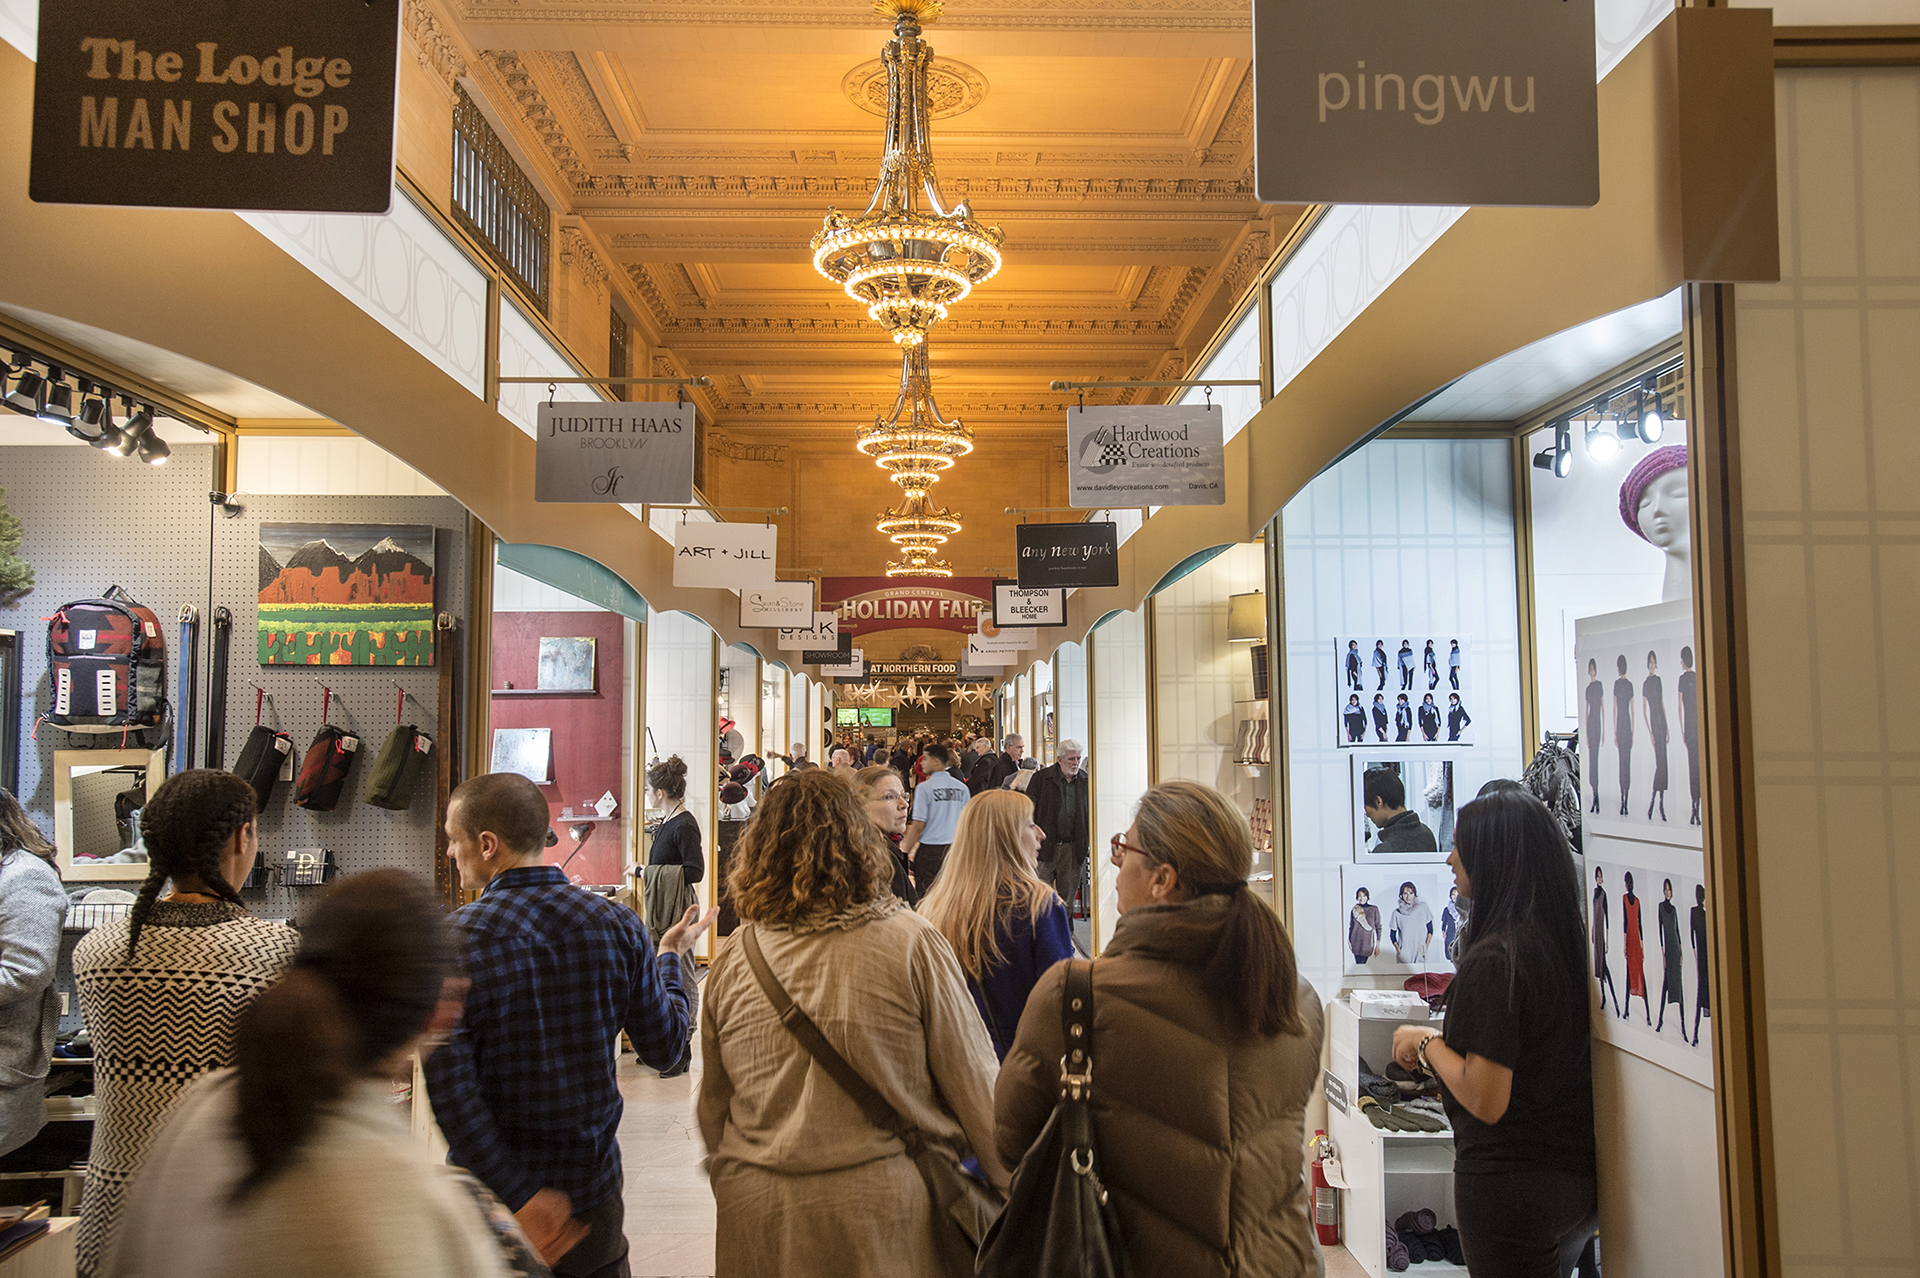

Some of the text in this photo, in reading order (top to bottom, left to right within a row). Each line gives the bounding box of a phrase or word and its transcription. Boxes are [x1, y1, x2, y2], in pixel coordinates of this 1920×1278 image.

[80, 37, 352, 97] The Lodge
[1318, 60, 1536, 126] pingwu
[80, 96, 349, 155] MAN SHOP
[549, 417, 682, 438] JUDITH HAAS
[1112, 424, 1189, 443] Hardwood
[580, 437, 649, 450] BROOKLYN
[1128, 442, 1200, 459] Creations
[1150, 461, 1185, 470] woodcrafted
[1185, 460, 1210, 469] products
[1076, 483, 1170, 492] www.davidlevycreations.com
[679, 546, 715, 559] ART
[733, 548, 771, 559] JILL
[1022, 542, 1111, 562] any new york
[884, 589, 944, 598] GRAND CENTRAL
[1009, 589, 1049, 598] THOMPSON
[1026, 597, 1032, 605] &
[842, 600, 933, 621] HOLIDAY
[1010, 605, 1049, 614] BLEECKER
[804, 651, 850, 659] SHOWROOM
[870, 664, 881, 673] AT
[882, 664, 931, 673] NORTHERN
[932, 664, 956, 673] FOOD
[933, 787, 964, 802] SECURITY
